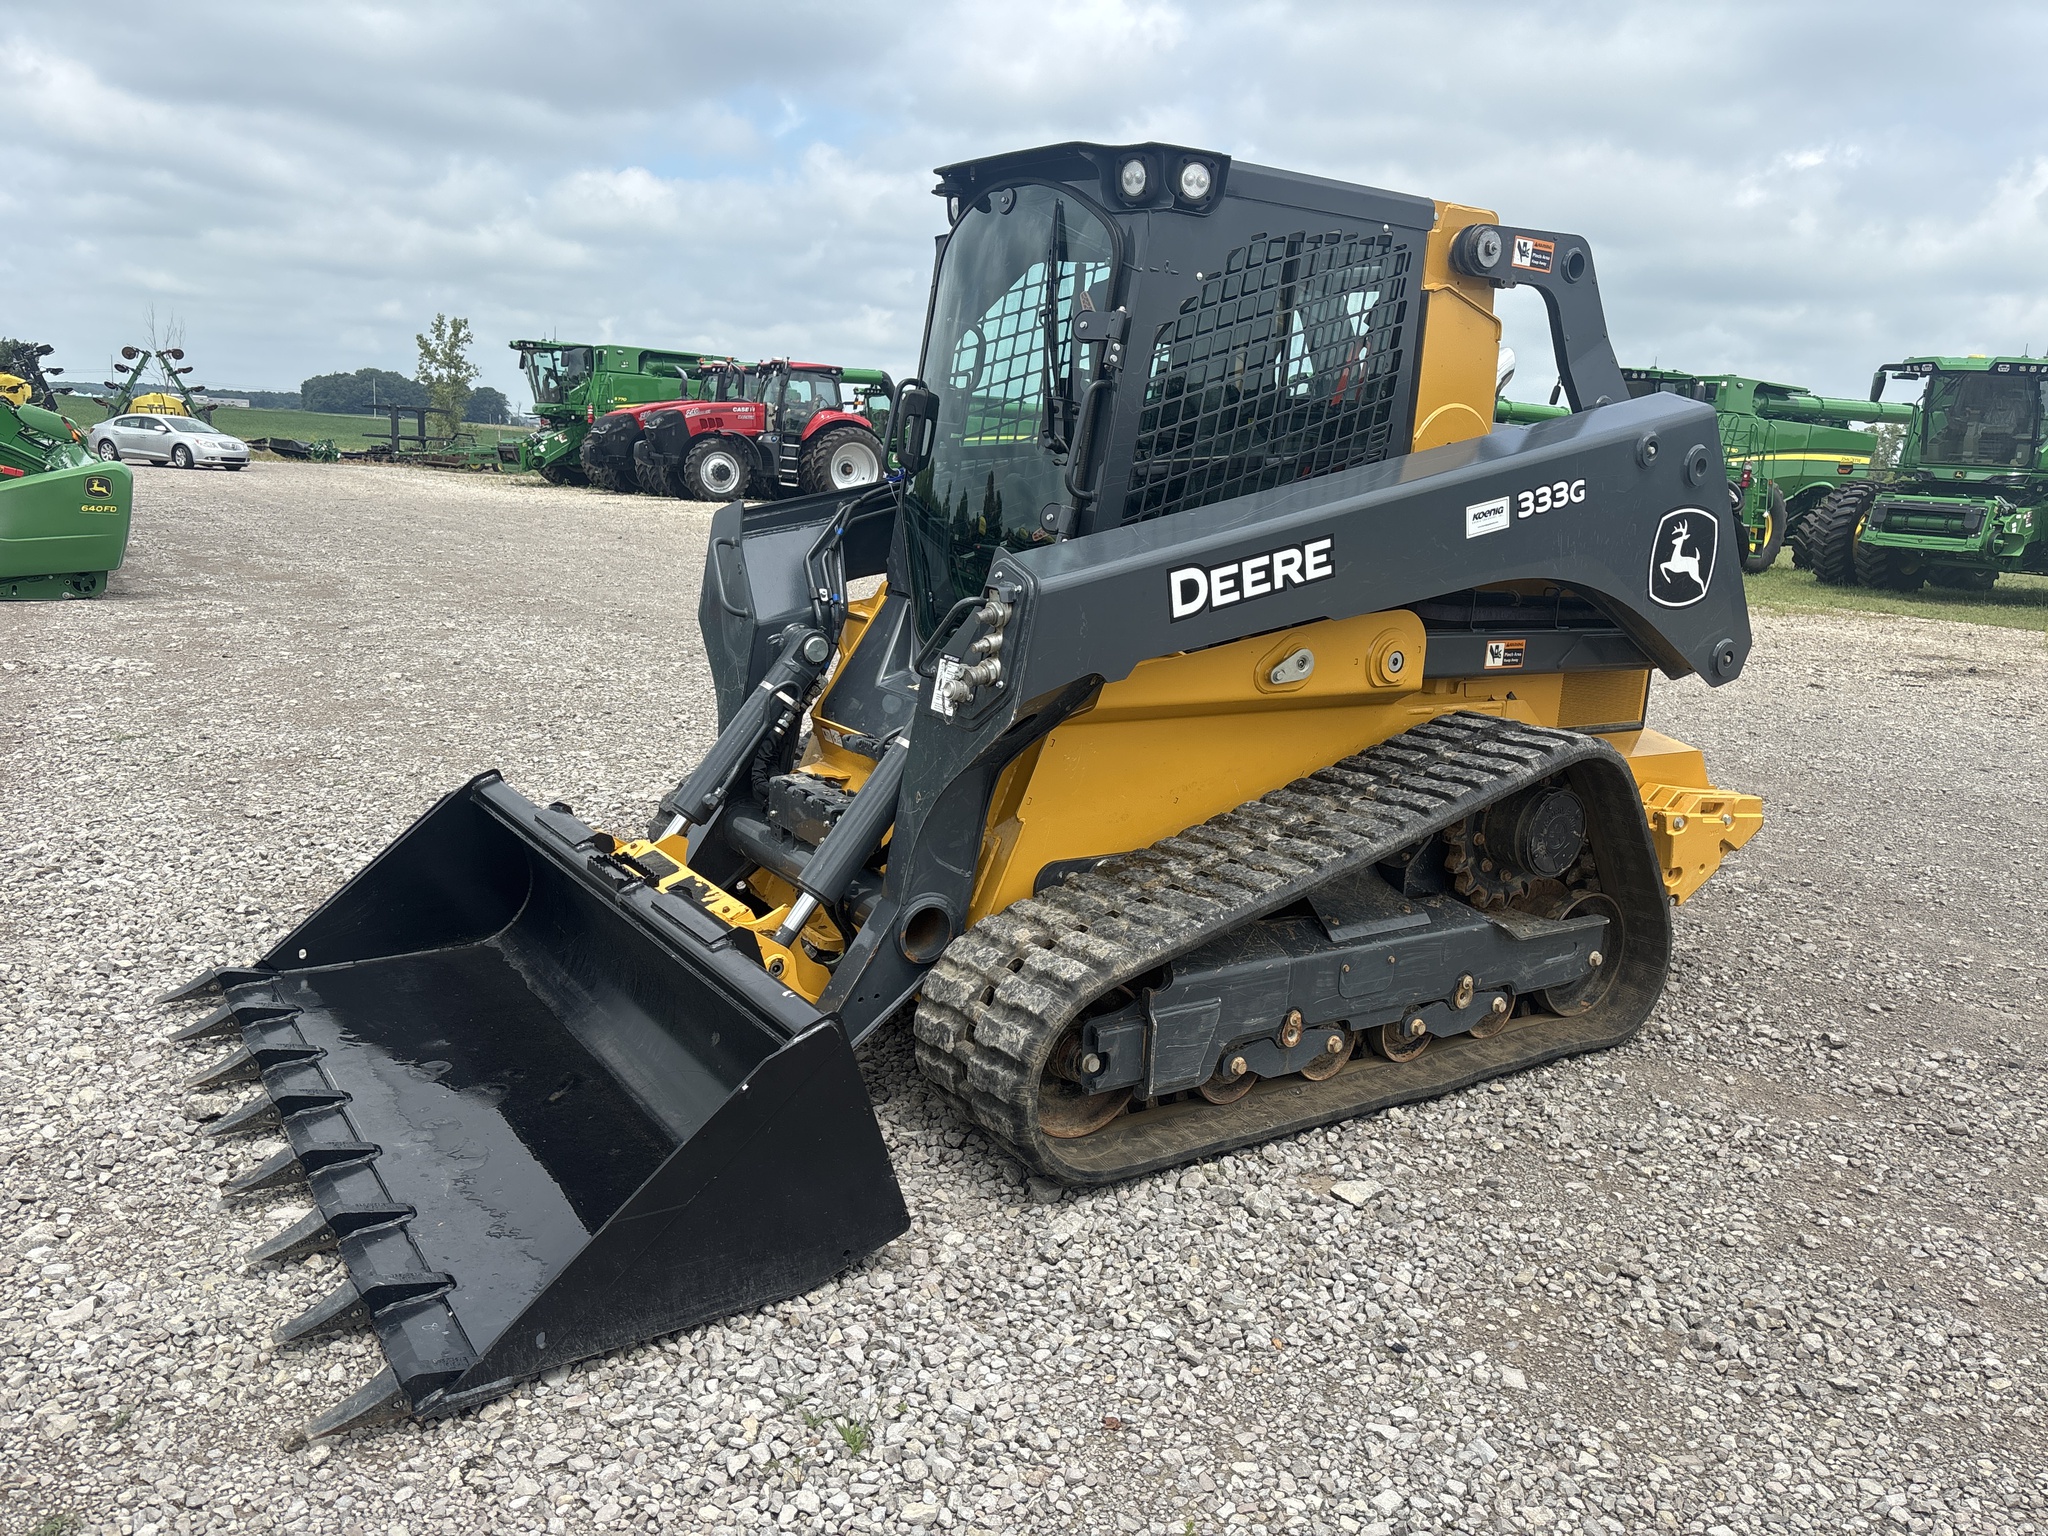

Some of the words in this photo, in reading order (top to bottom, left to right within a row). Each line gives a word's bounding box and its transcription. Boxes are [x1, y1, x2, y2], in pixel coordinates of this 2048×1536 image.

[81, 504, 118, 513] 640FD
[1517, 479, 1587, 519] 333G
[1170, 538, 1333, 619] DEERE
